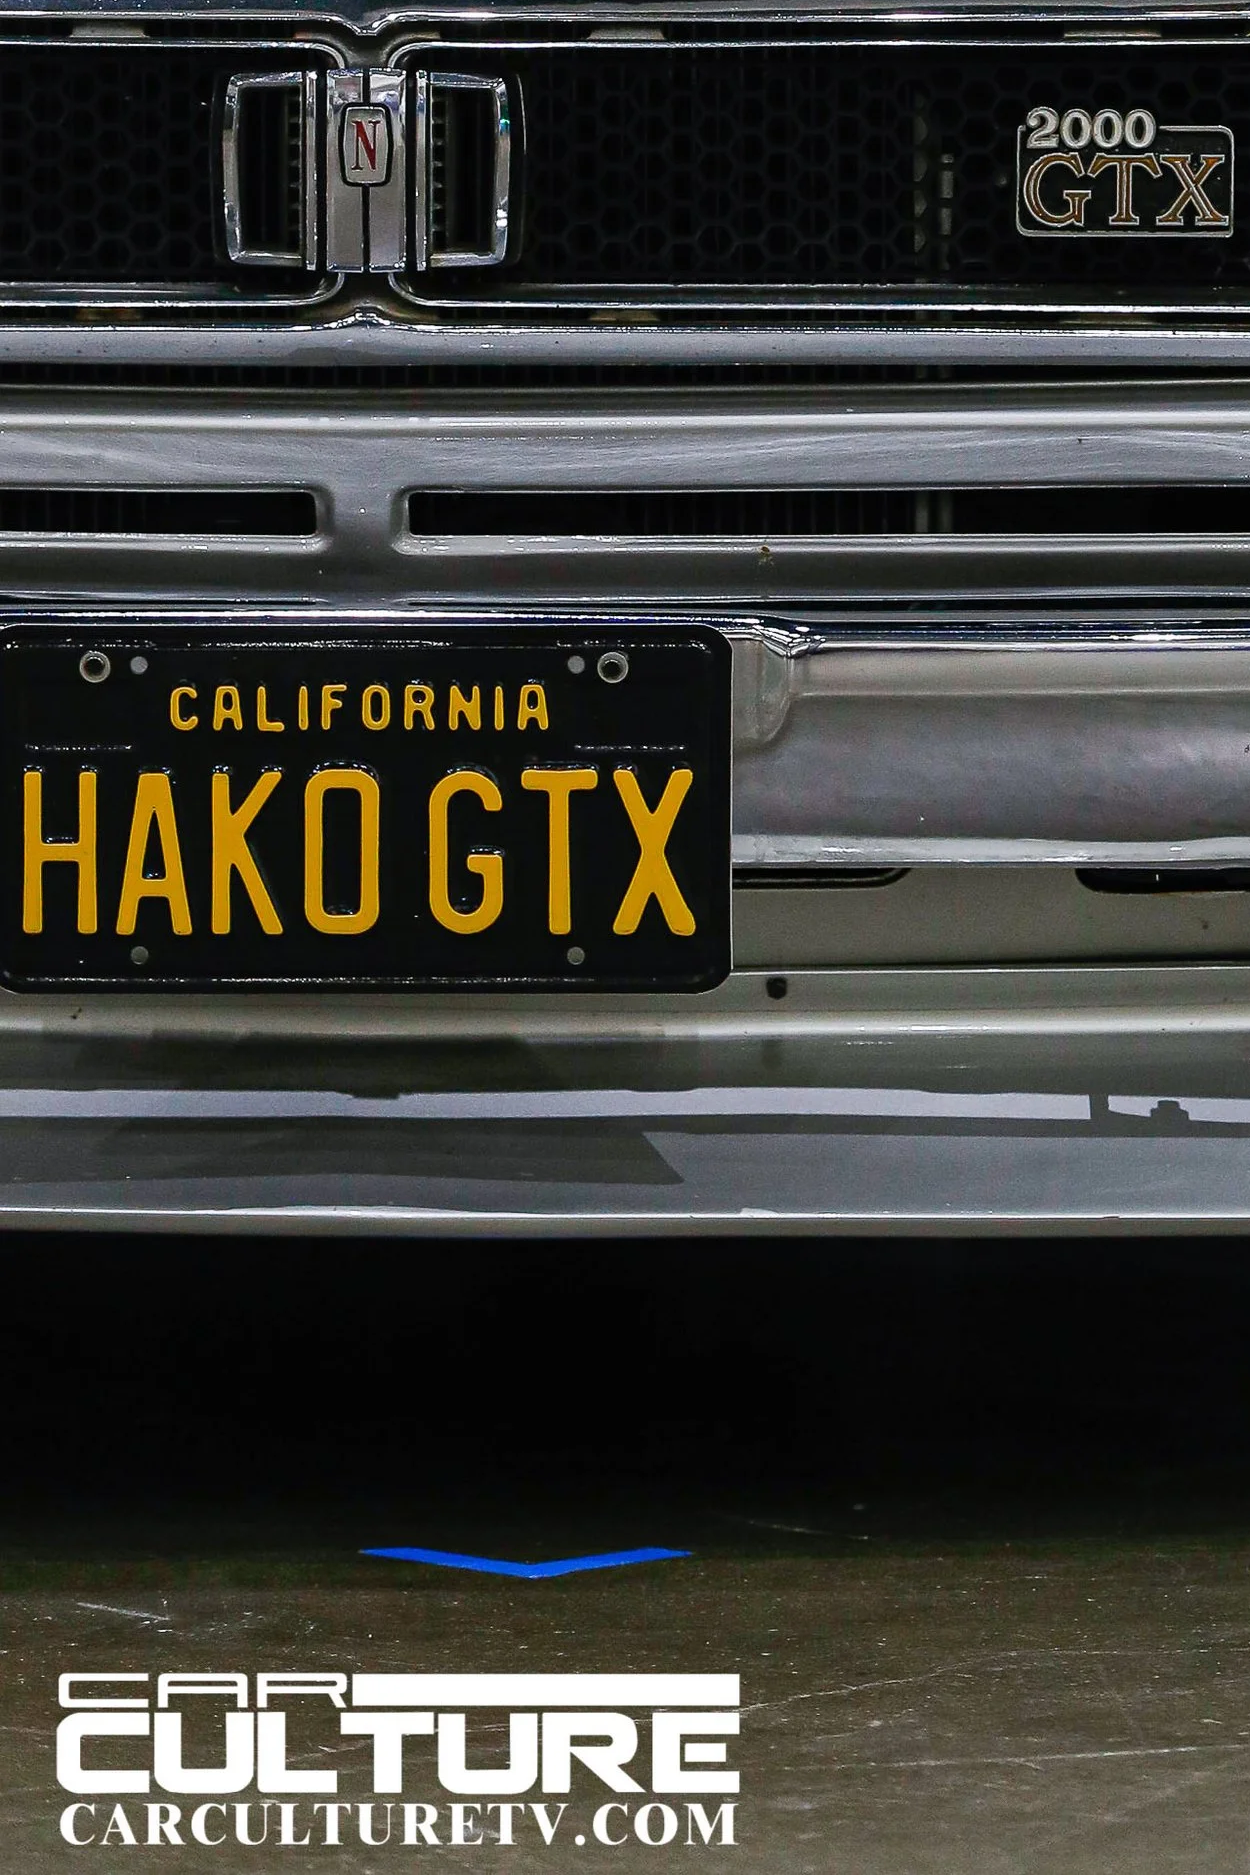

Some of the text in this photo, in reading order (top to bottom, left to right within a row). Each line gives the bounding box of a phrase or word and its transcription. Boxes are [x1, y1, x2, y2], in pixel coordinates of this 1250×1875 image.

[350, 119, 382, 171] N
[1026, 106, 1157, 149] 2000
[1023, 151, 1230, 228] GTX
[170, 685, 549, 731] CALIFORNIA
[22, 768, 697, 936] HAKO GTX
